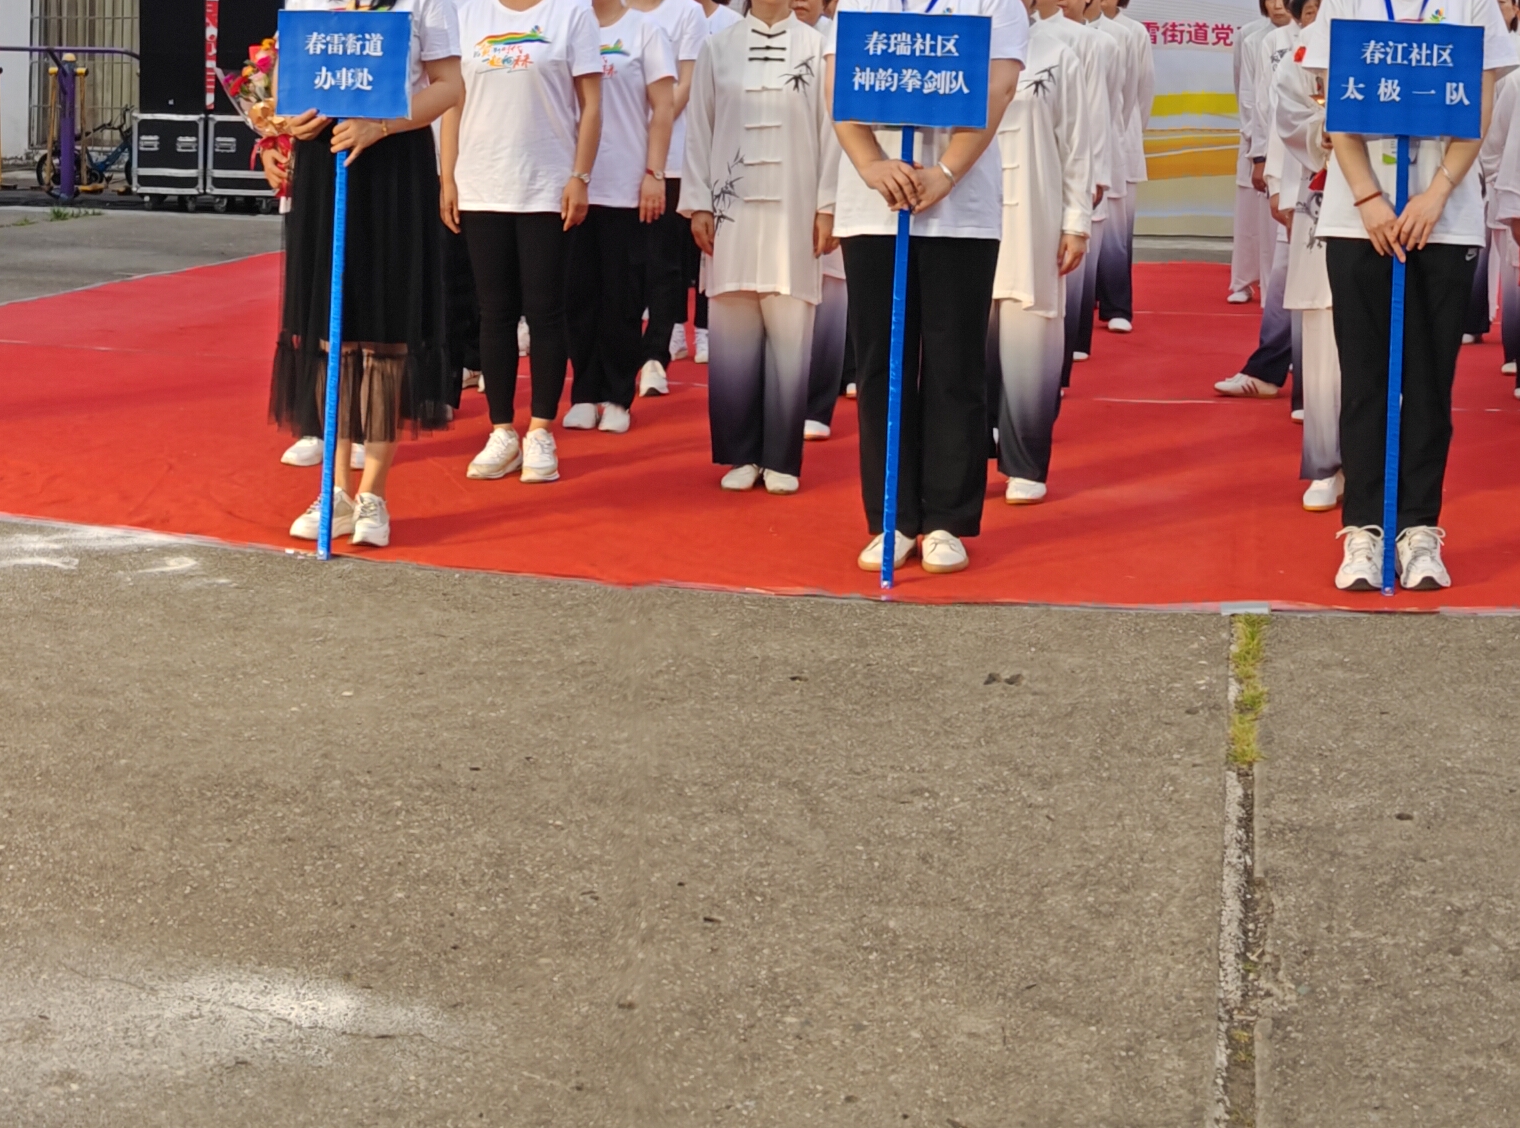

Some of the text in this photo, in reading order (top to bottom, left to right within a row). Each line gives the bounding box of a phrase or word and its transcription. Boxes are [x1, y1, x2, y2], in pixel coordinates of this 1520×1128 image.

[305, 32, 383, 56] 春雷街道
[865, 31, 958, 56] 春瑞社区
[1144, 20, 1242, 47] 雷街道党
[1363, 40, 1452, 66] 春江社区
[314, 67, 373, 90] 办事处
[853, 67, 969, 94] 神韵拳剑队
[1341, 77, 1470, 105] 太极一队
